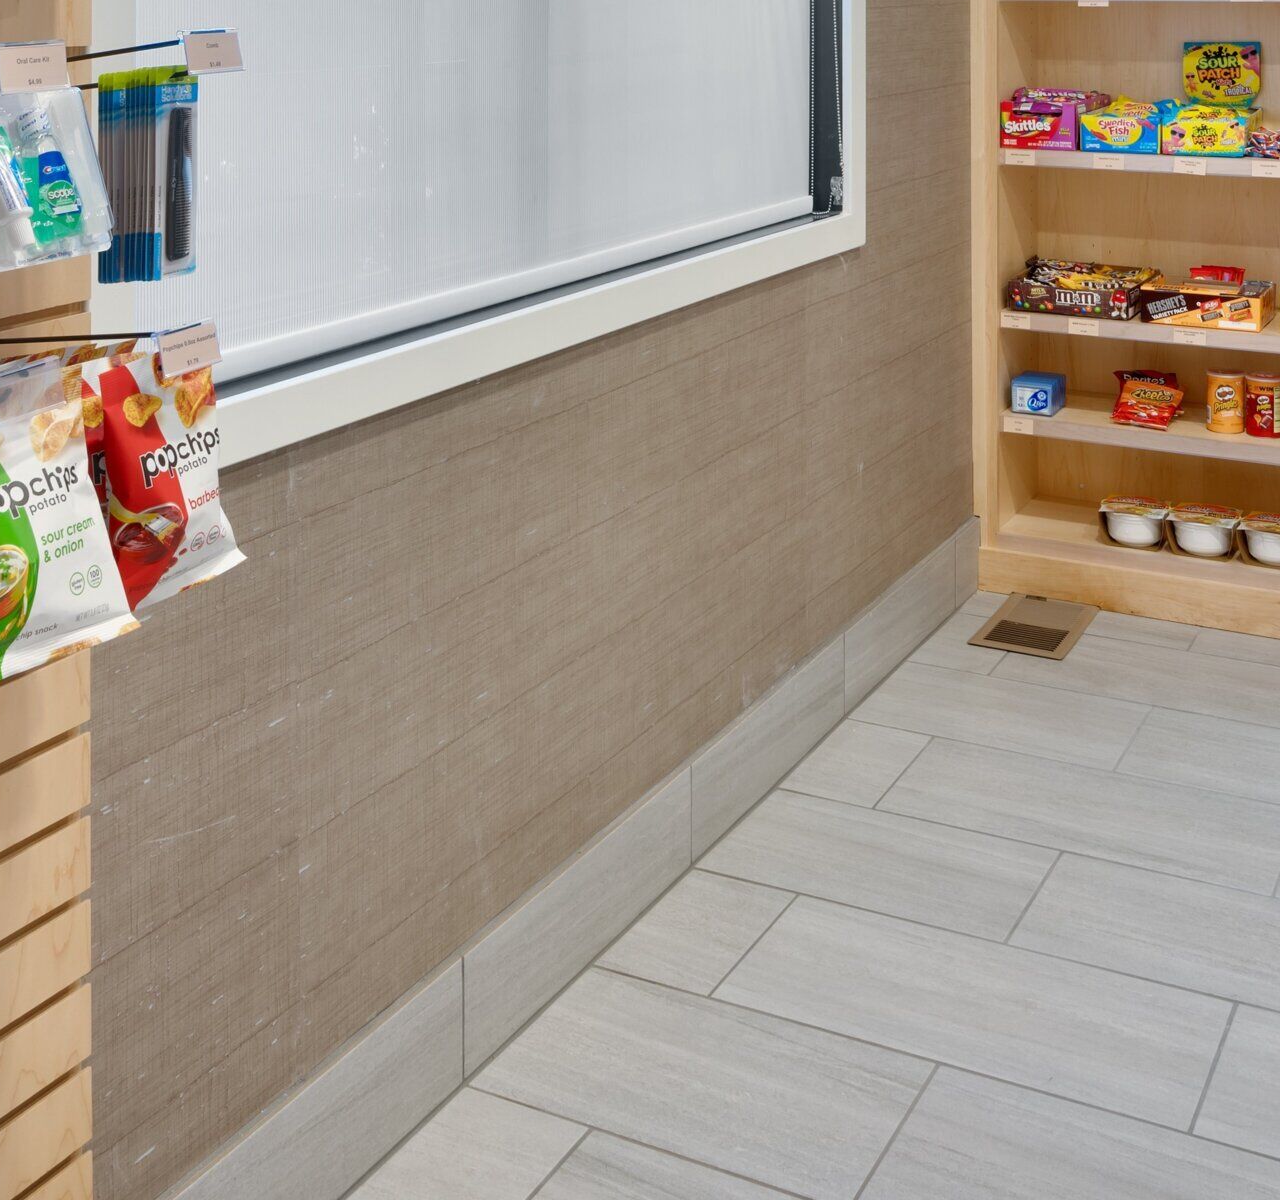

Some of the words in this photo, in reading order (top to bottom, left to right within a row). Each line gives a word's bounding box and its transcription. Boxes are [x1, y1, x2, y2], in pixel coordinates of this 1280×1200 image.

[16, 56, 28, 64] Oral
[29, 56, 40, 64] Care
[42, 55, 50, 63] Kit
[1199, 56, 1240, 69] SOUR
[1198, 68, 1240, 79] PATCH
[1224, 87, 1253, 96] TROPICAL
[1004, 119, 1051, 134] Skittles
[1098, 119, 1136, 130] Swedish
[1108, 126, 1130, 136] Fish
[1193, 128, 1216, 136] SOUR
[1193, 135, 1218, 143] PATCH
[47, 188, 74, 200] scope
[1146, 295, 1186, 315] HERSHEY'S
[1151, 309, 1172, 320] VARIETY
[1172, 306, 1188, 316] PACK
[1130, 388, 1173, 403] Cheetos
[1214, 400, 1239, 413] Pringles
[140, 427, 220, 488] popchips
[177, 456, 208, 477] potato
[29, 493, 67, 516] potato
[41, 528, 65, 546] sour
[66, 517, 95, 536] cream
[35, 623, 58, 637] snack
